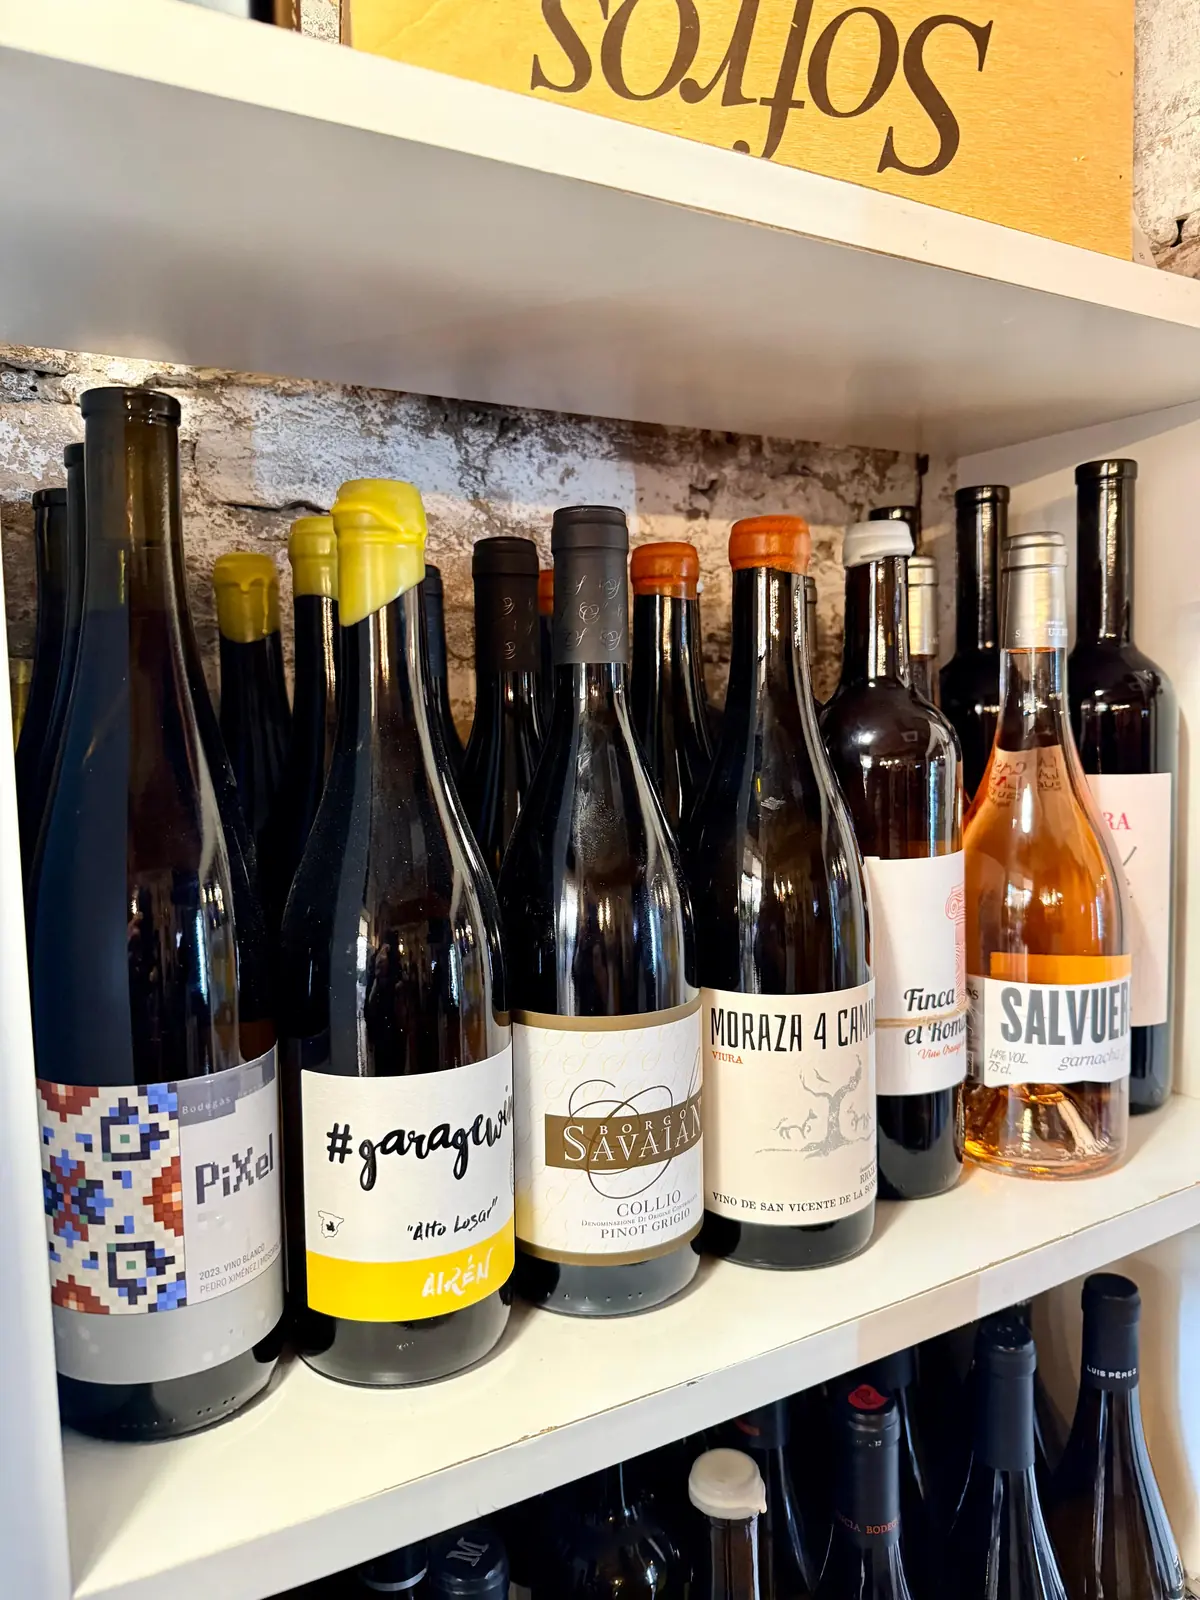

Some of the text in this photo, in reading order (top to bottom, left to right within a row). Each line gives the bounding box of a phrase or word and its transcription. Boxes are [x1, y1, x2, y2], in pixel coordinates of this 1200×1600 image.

[530, 0, 992, 176] Sofros
[903, 987, 955, 1012] Finca
[710, 1007, 802, 1052] MORAZA
[813, 1012, 826, 1050] 4
[904, 1025, 923, 1045] el
[711, 1050, 743, 1064] VIURA
[987, 1060, 999, 1072] 75
[989, 1048, 1029, 1065] 14% VOL.
[182, 1096, 232, 1115] Bodegas
[599, 1108, 687, 1135] BORGO
[616, 1189, 681, 1217] COLLIO
[712, 1191, 737, 1206] VINO
[741, 1199, 757, 1210] DE
[760, 1202, 784, 1212] SAN
[789, 1198, 837, 1212] VICENTE
[839, 1194, 851, 1206] DE
[853, 1189, 863, 1200] LA
[601, 1207, 691, 1239] PINOT GRIGIO
[223, 1257, 242, 1272] VINO
[242, 1242, 265, 1264] BLANCO
[199, 1277, 227, 1294] PEDRO
[228, 1261, 257, 1284] XIMÉNEZ
[1087, 1364, 1106, 1377] LUIS
[446, 1536, 489, 1567] M
